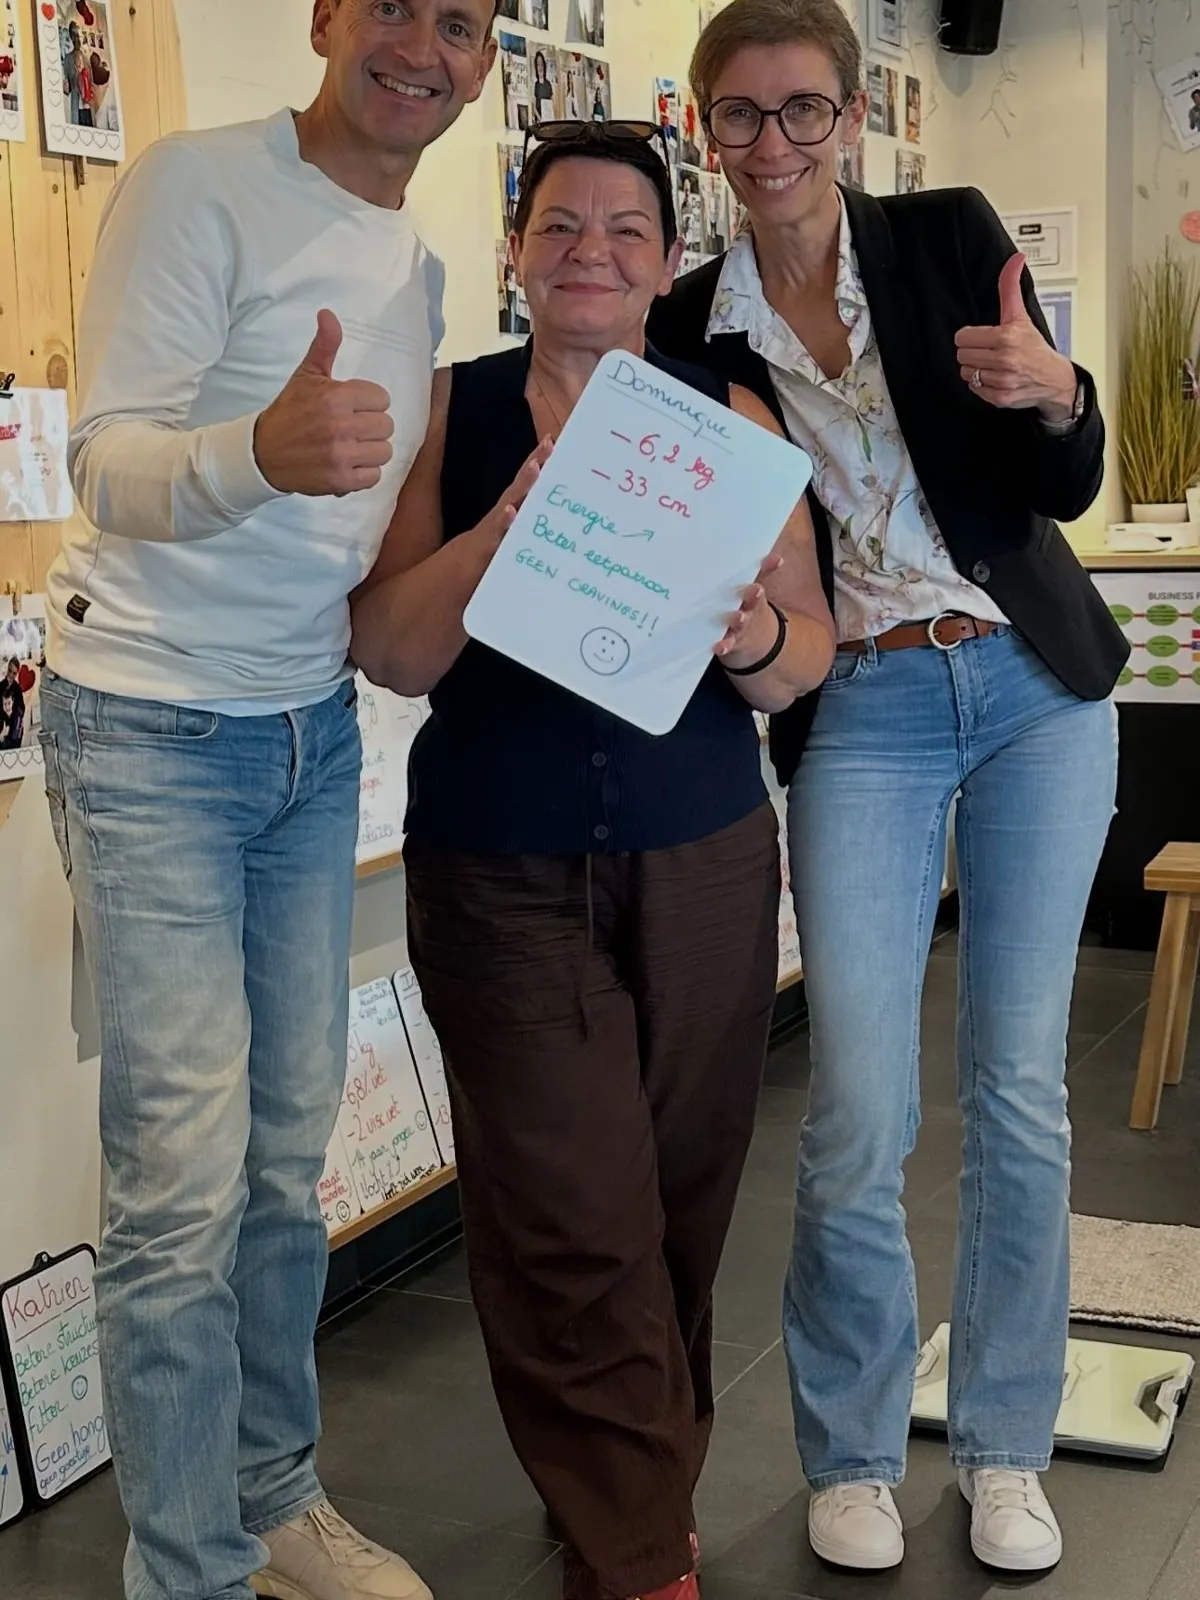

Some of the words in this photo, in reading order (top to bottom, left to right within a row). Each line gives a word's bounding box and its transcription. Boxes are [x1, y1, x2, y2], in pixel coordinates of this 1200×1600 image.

[607, 360, 731, 438] Dominique
[685, 456, 714, 490] kg
[546, 484, 618, 535] Energie
[658, 494, 691, 518] cm
[532, 514, 577, 553] Beter
[515, 549, 559, 579] GEEN
[1148, 592, 1194, 600] BUSINESS
[6, 1277, 89, 1328] Katrien
[15, 1343, 56, 1377] Betere
[20, 1368, 61, 1407] Betere
[36, 1442, 70, 1472] Geen
